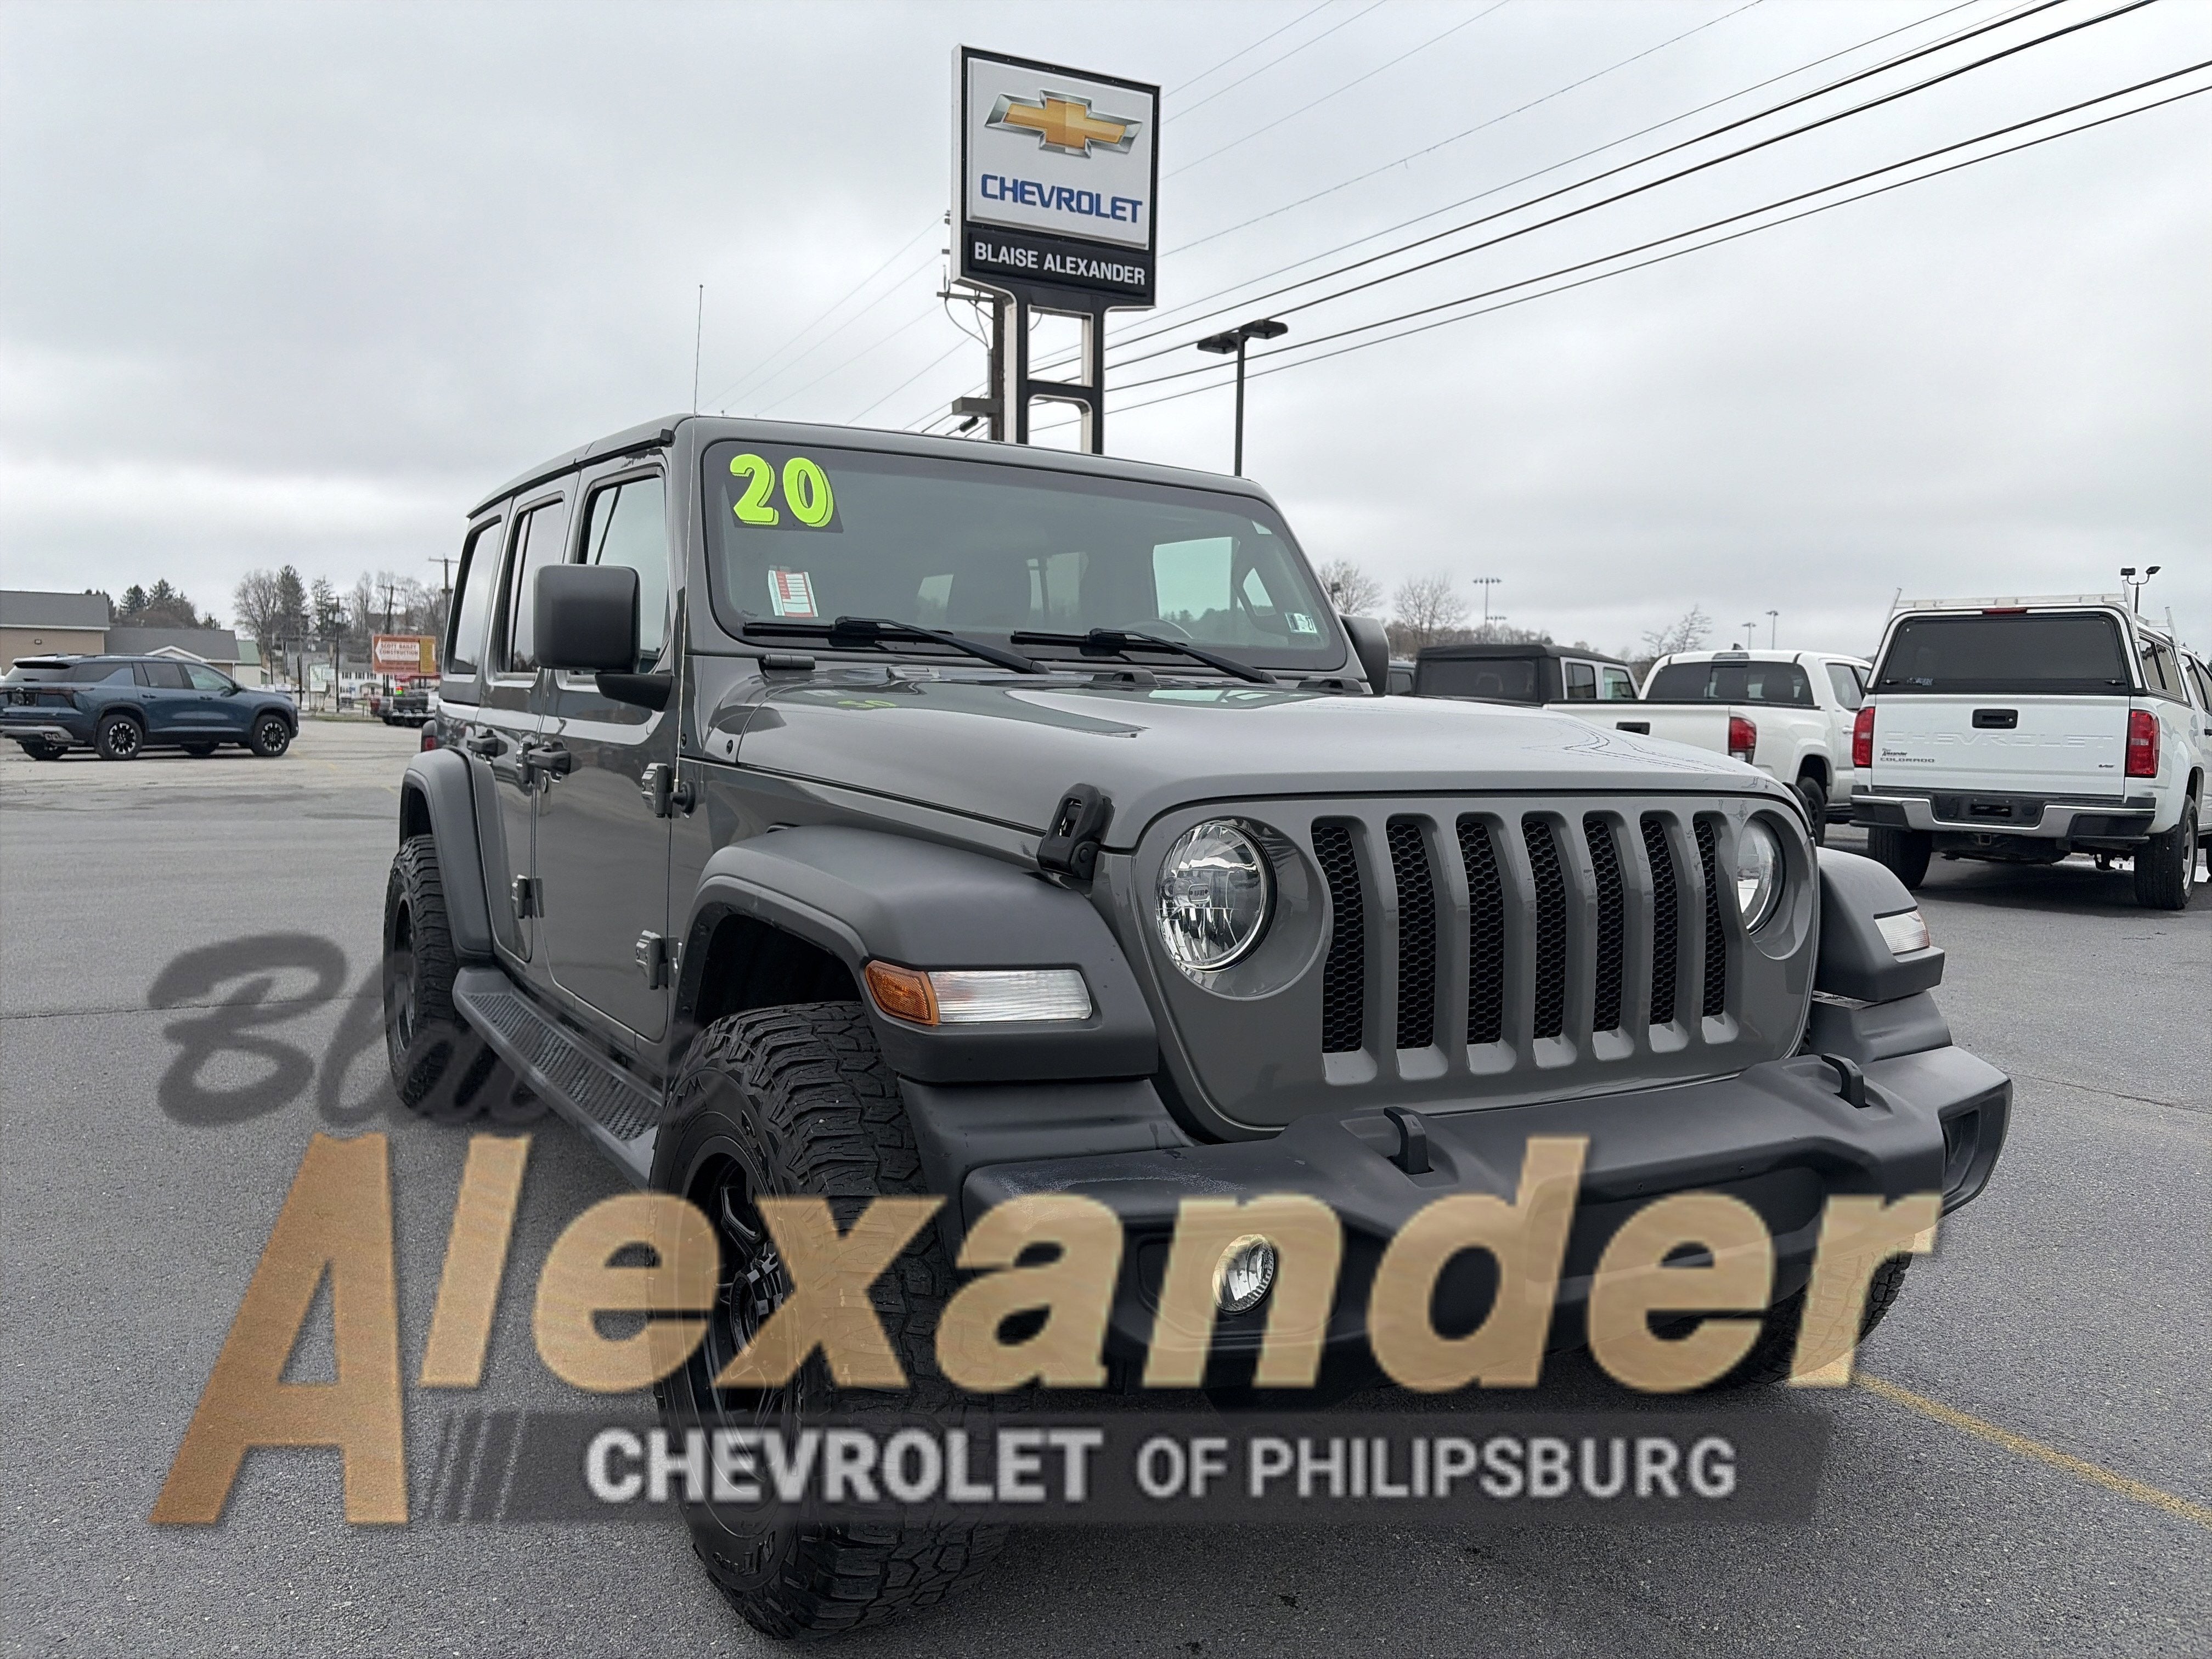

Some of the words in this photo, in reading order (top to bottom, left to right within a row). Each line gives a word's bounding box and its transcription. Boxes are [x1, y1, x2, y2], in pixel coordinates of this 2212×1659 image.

[981, 173, 1142, 223] CHEVROLET
[975, 241, 1039, 269] BLAISE
[1043, 254, 1146, 285] ALEXANDER
[730, 453, 834, 528] 20
[1884, 731, 2114, 748] CHEVROLET
